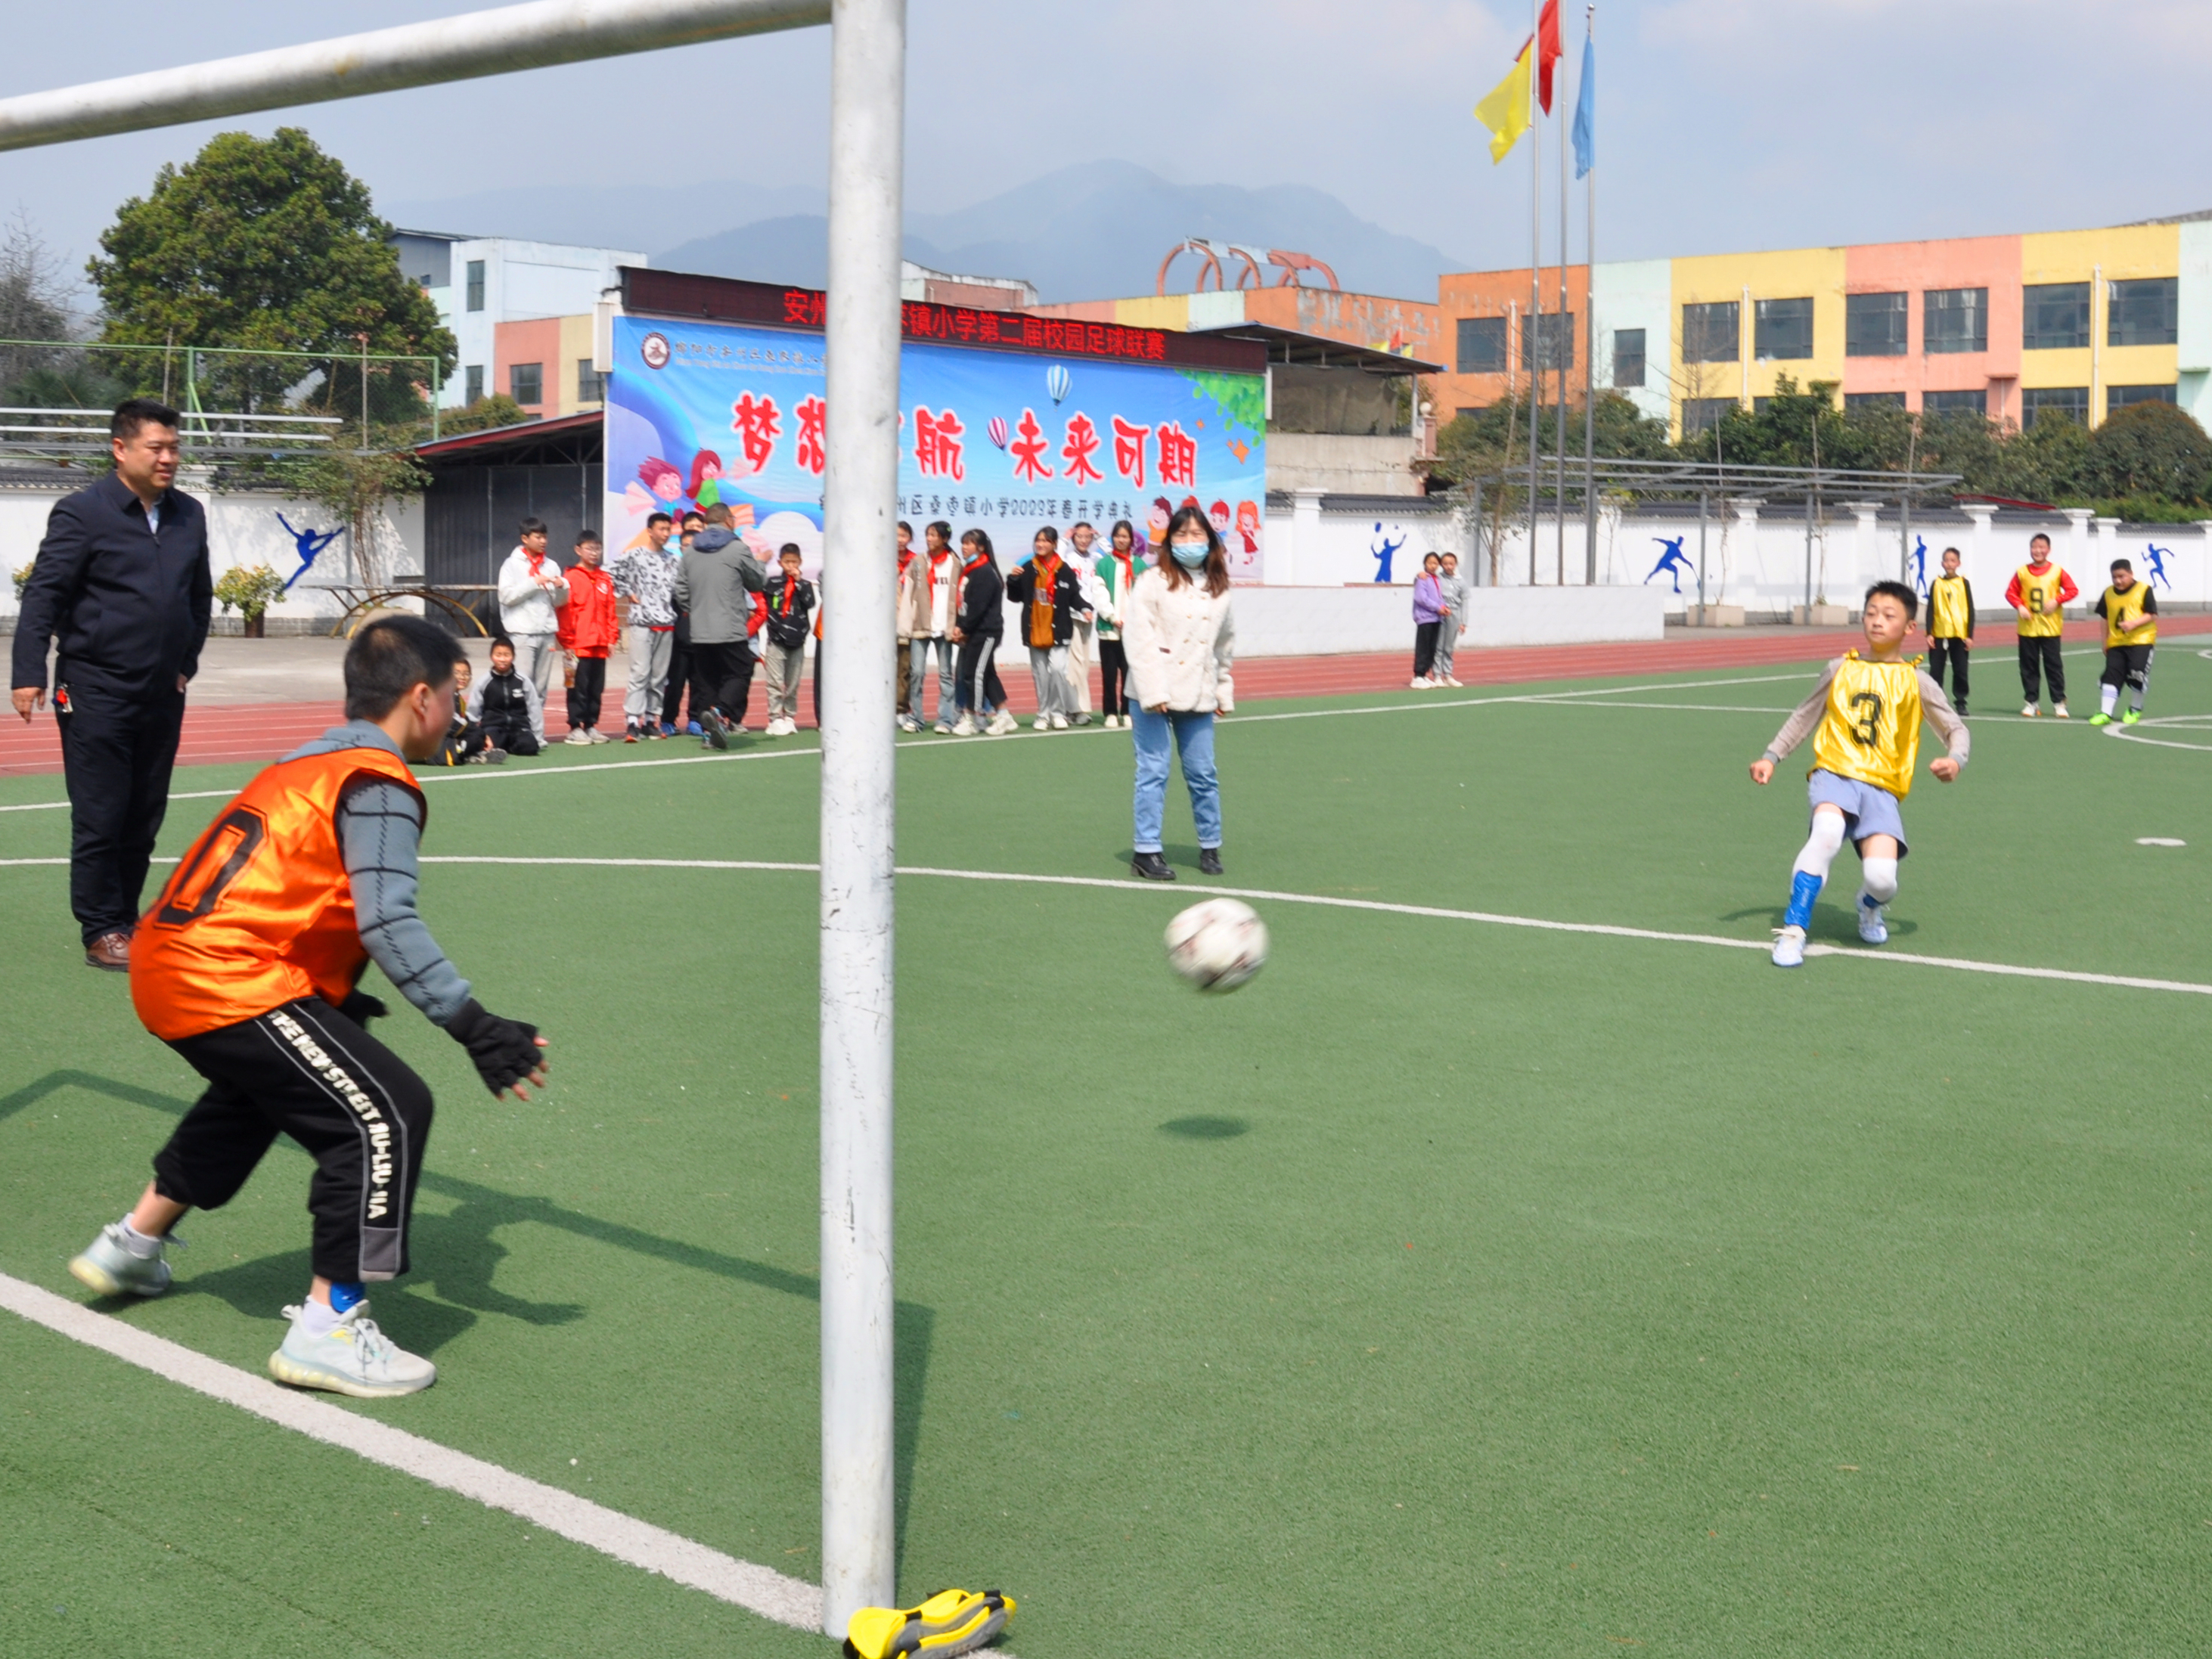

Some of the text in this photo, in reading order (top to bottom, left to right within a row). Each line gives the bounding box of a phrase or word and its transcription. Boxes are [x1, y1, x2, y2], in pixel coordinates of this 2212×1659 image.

[731, 391, 1197, 489] 梦想航 未来可期
[1850, 690, 1884, 748] 3
